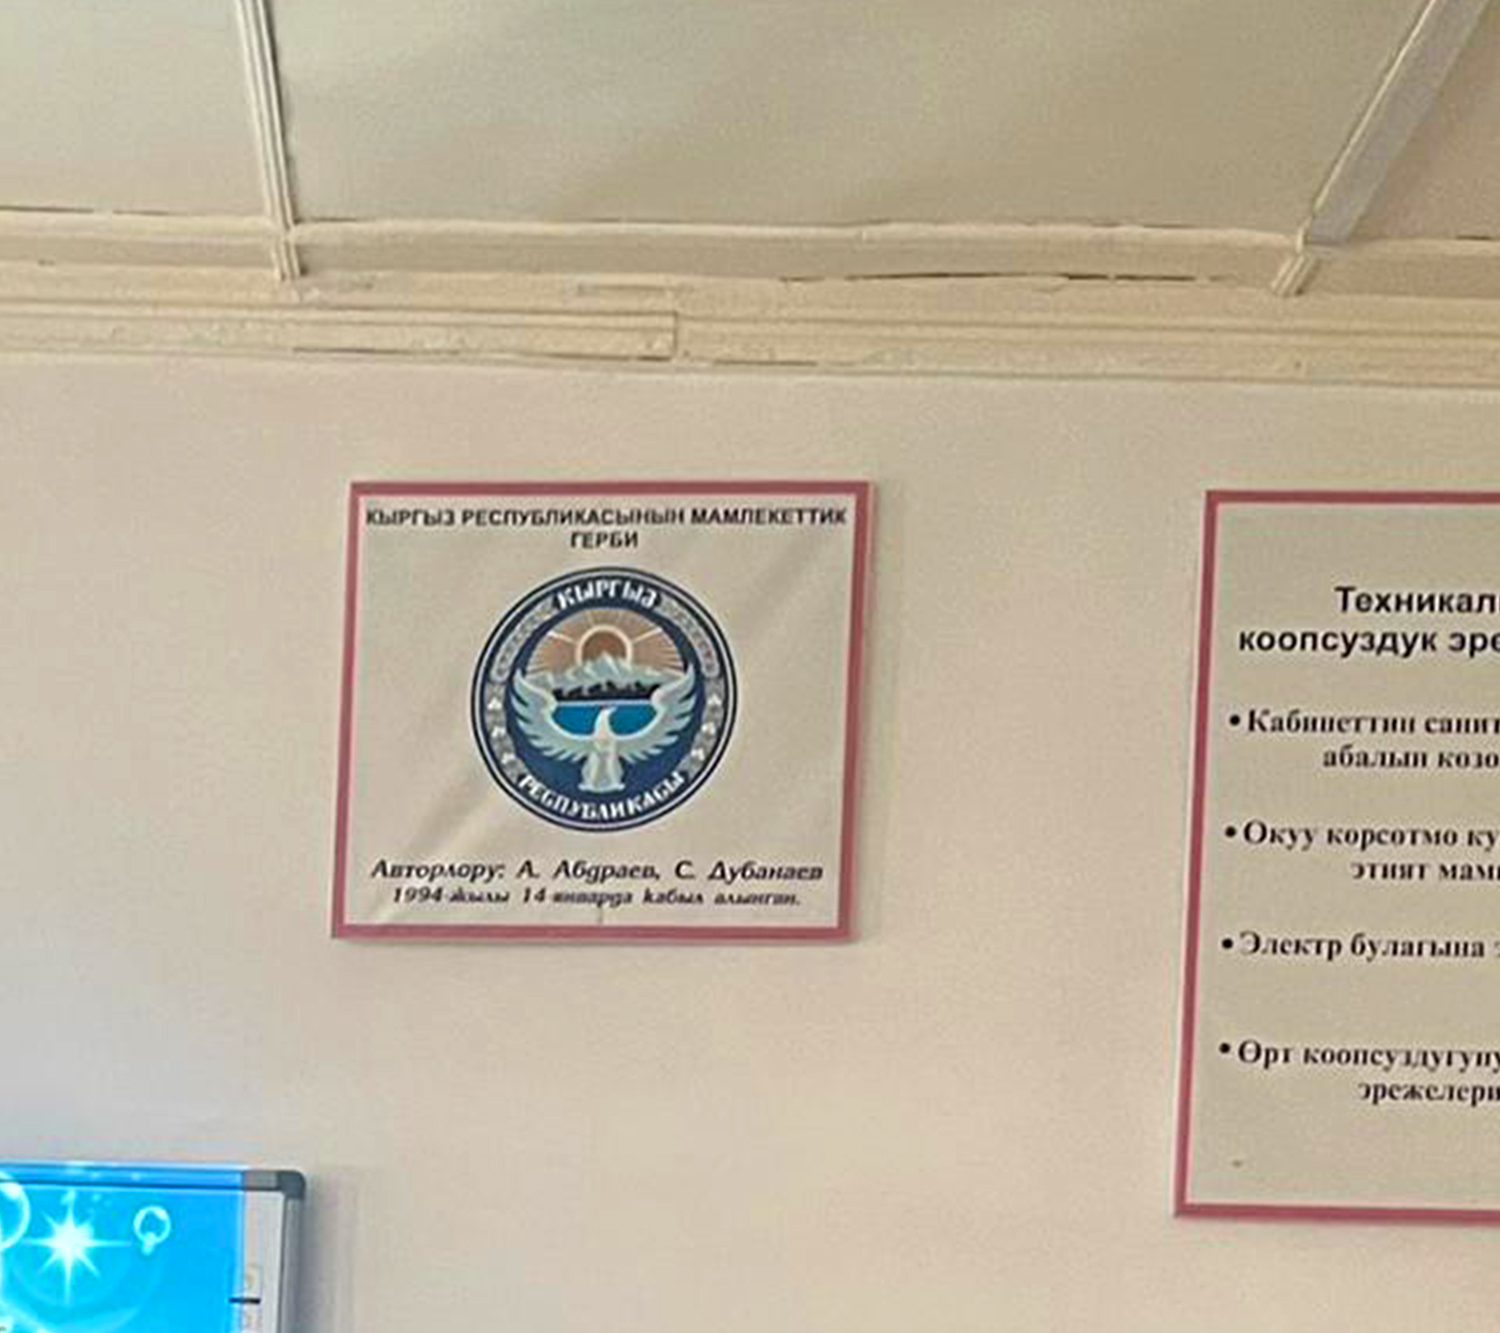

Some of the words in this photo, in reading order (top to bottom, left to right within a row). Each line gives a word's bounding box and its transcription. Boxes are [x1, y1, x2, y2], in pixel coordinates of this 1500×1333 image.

[366, 508, 456, 526] КЫРГЫЗ
[461, 508, 685, 527] РЕСПУБЛИКАСЫНЫН
[690, 508, 847, 526] МАМЛЕКЕТТИК
[570, 532, 638, 549] ГЕРБИ
[554, 578, 660, 612] КЫРГЫЗ
[1238, 629, 1437, 658] коопсуздук
[1247, 708, 1417, 736] Кабинеттин
[1321, 744, 1429, 771] абалын
[517, 773, 687, 821] РЕСПУБЛИКАСЫ
[1243, 819, 1316, 852] Окуу
[1326, 827, 1459, 852] корсотмо
[371, 859, 504, 883] Авторлору:
[553, 859, 660, 883] Абдраев,
[707, 860, 822, 885] Дубанаев
[1350, 861, 1429, 884] этият
[1239, 930, 1343, 959] Электр
[1349, 933, 1486, 959] булагына
[1237, 1038, 1295, 1066] Өрт
